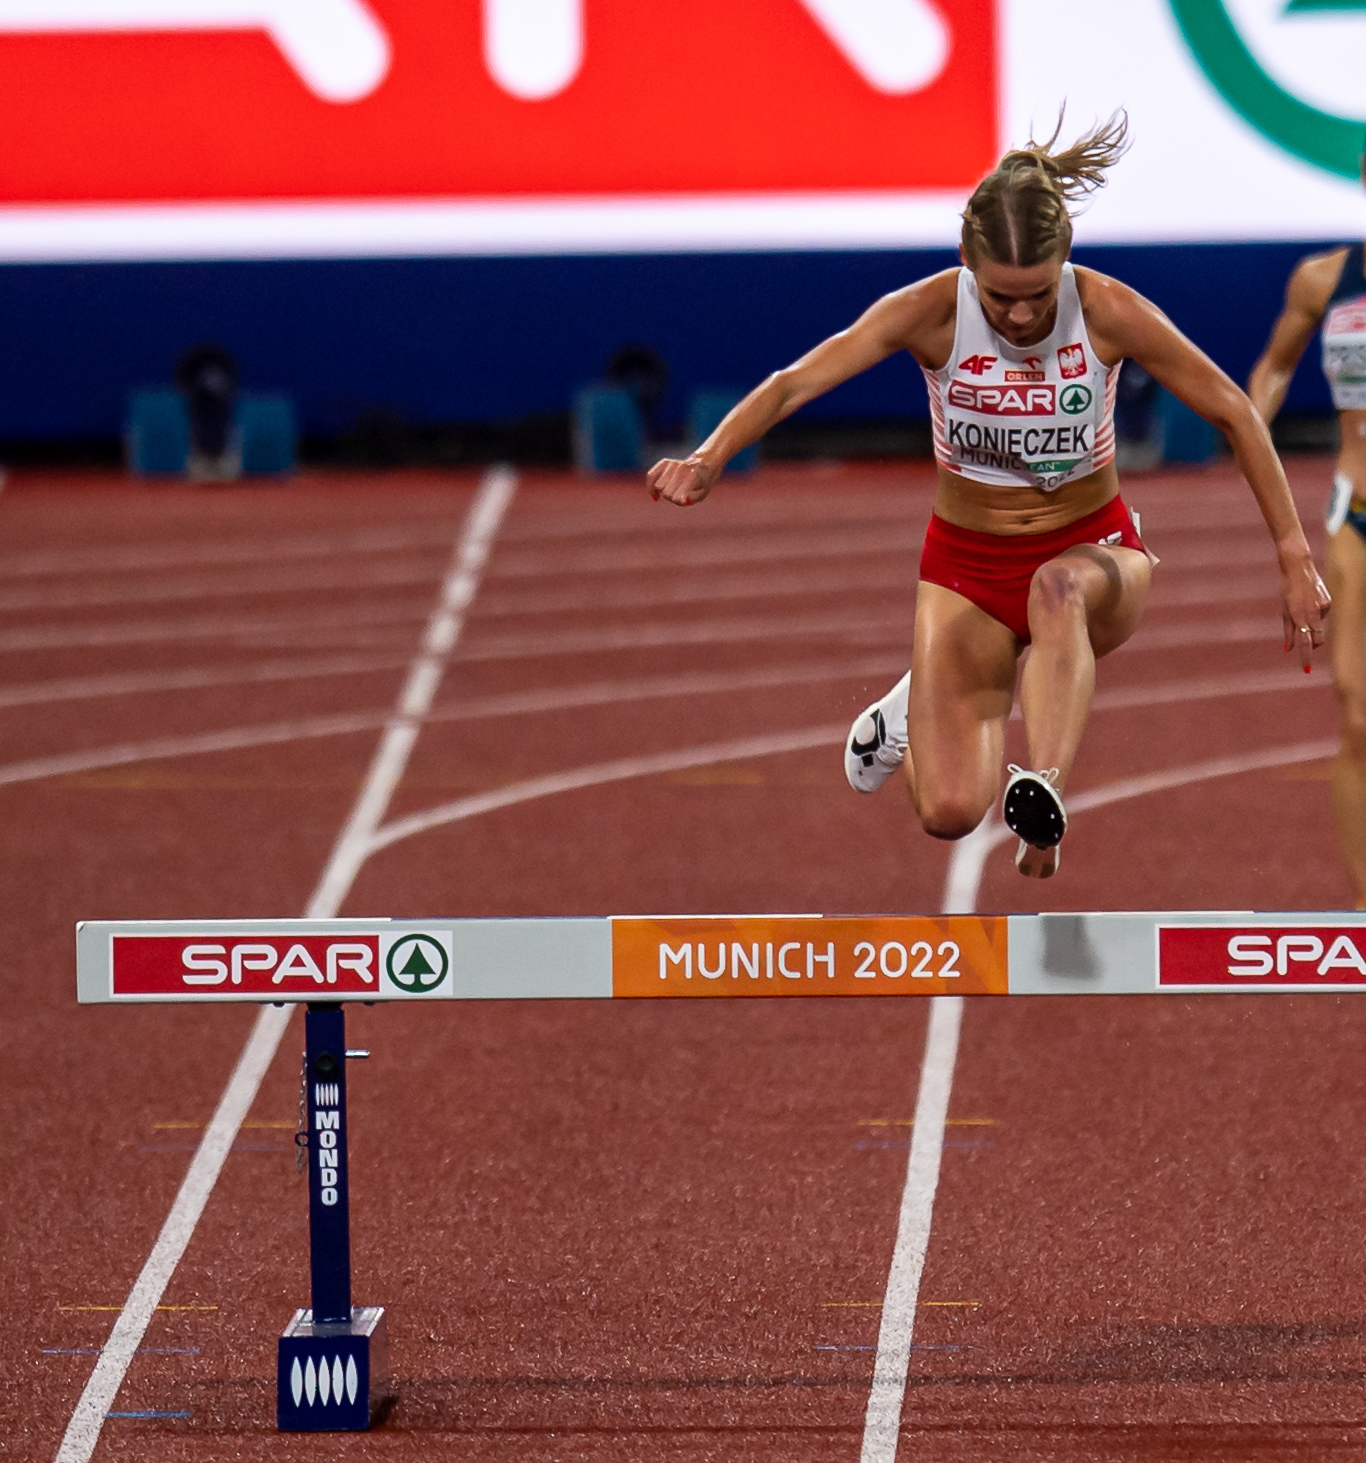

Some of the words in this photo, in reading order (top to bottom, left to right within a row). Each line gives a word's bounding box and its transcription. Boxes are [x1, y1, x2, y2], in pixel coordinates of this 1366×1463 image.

[950, 385, 1053, 412] SPAR
[949, 419, 1089, 456] KONIECZEK
[960, 447, 1023, 470] MUNIC
[181, 943, 373, 985] SPAR
[658, 942, 836, 980] MUNICH
[853, 941, 961, 979] 2022
[315, 1110, 340, 1206] MONDO
